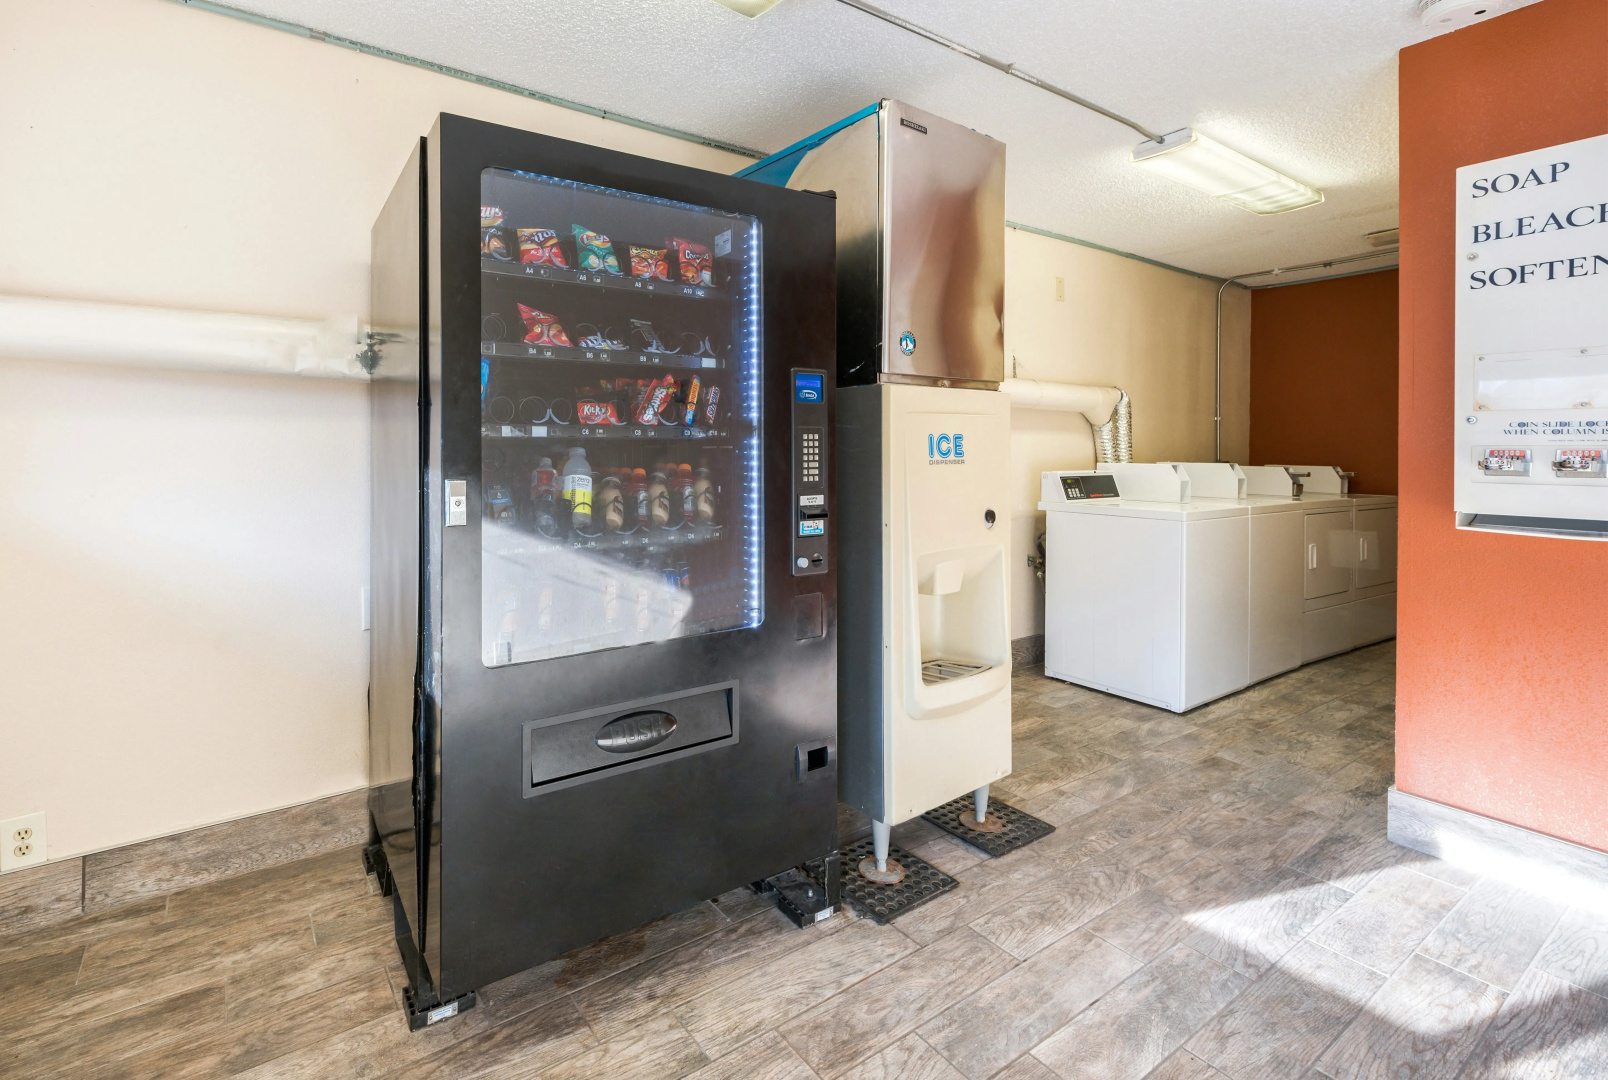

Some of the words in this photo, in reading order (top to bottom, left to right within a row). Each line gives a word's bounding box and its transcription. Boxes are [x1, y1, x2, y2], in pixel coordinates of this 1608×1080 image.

[1472, 161, 1570, 199] SOAP
[1503, 428, 1539, 436] WHEN
[928, 433, 965, 459] ICE
[577, 476, 590, 484] zero
[609, 715, 663, 747] PUSH
